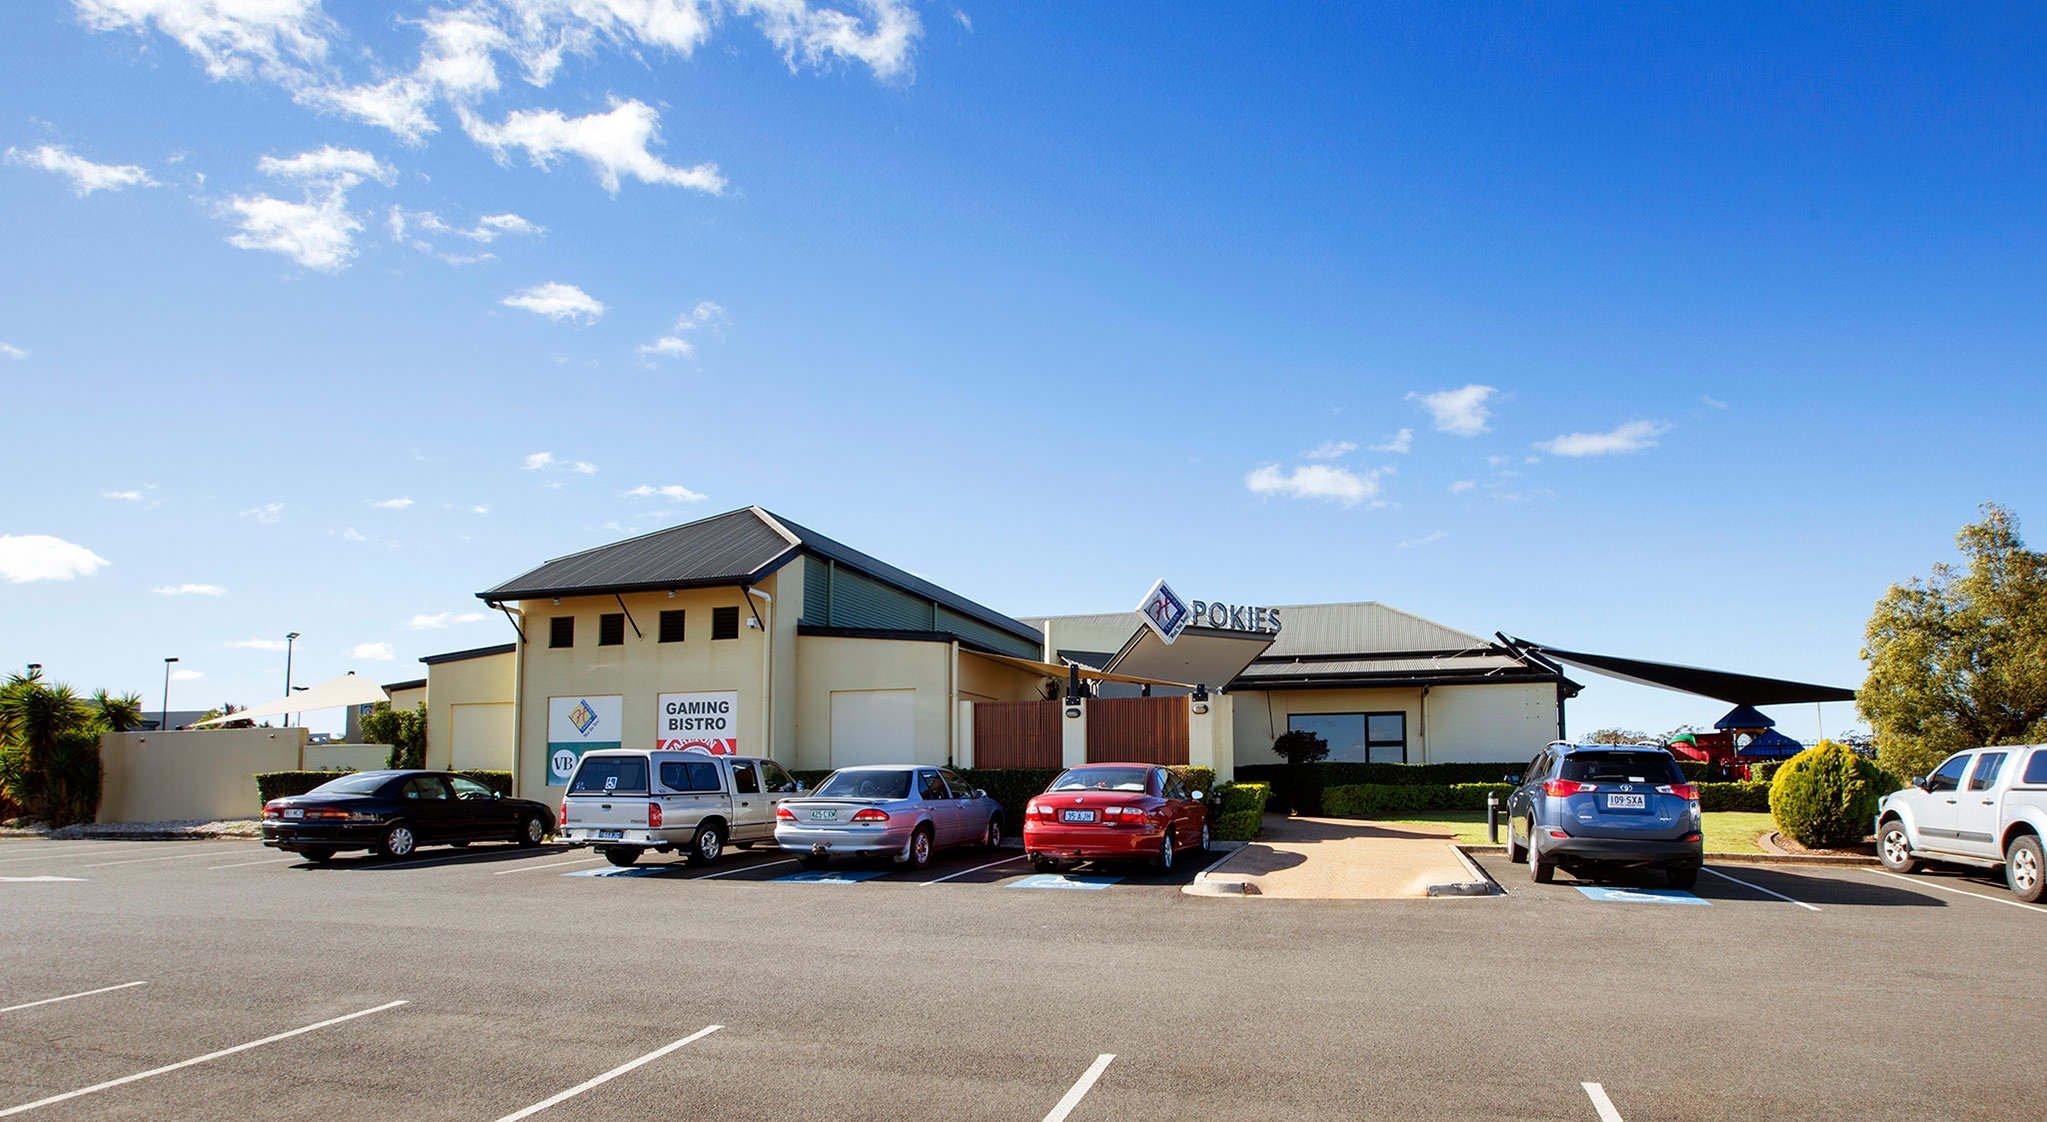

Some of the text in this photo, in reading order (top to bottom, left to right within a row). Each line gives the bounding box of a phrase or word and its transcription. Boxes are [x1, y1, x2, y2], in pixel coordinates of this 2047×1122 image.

[1192, 599, 1282, 633] POKIES
[666, 701, 730, 715] GAMING
[668, 717, 727, 731] BISTRO
[554, 756, 573, 771] VB
[1610, 795, 1643, 805] 109 SXA
